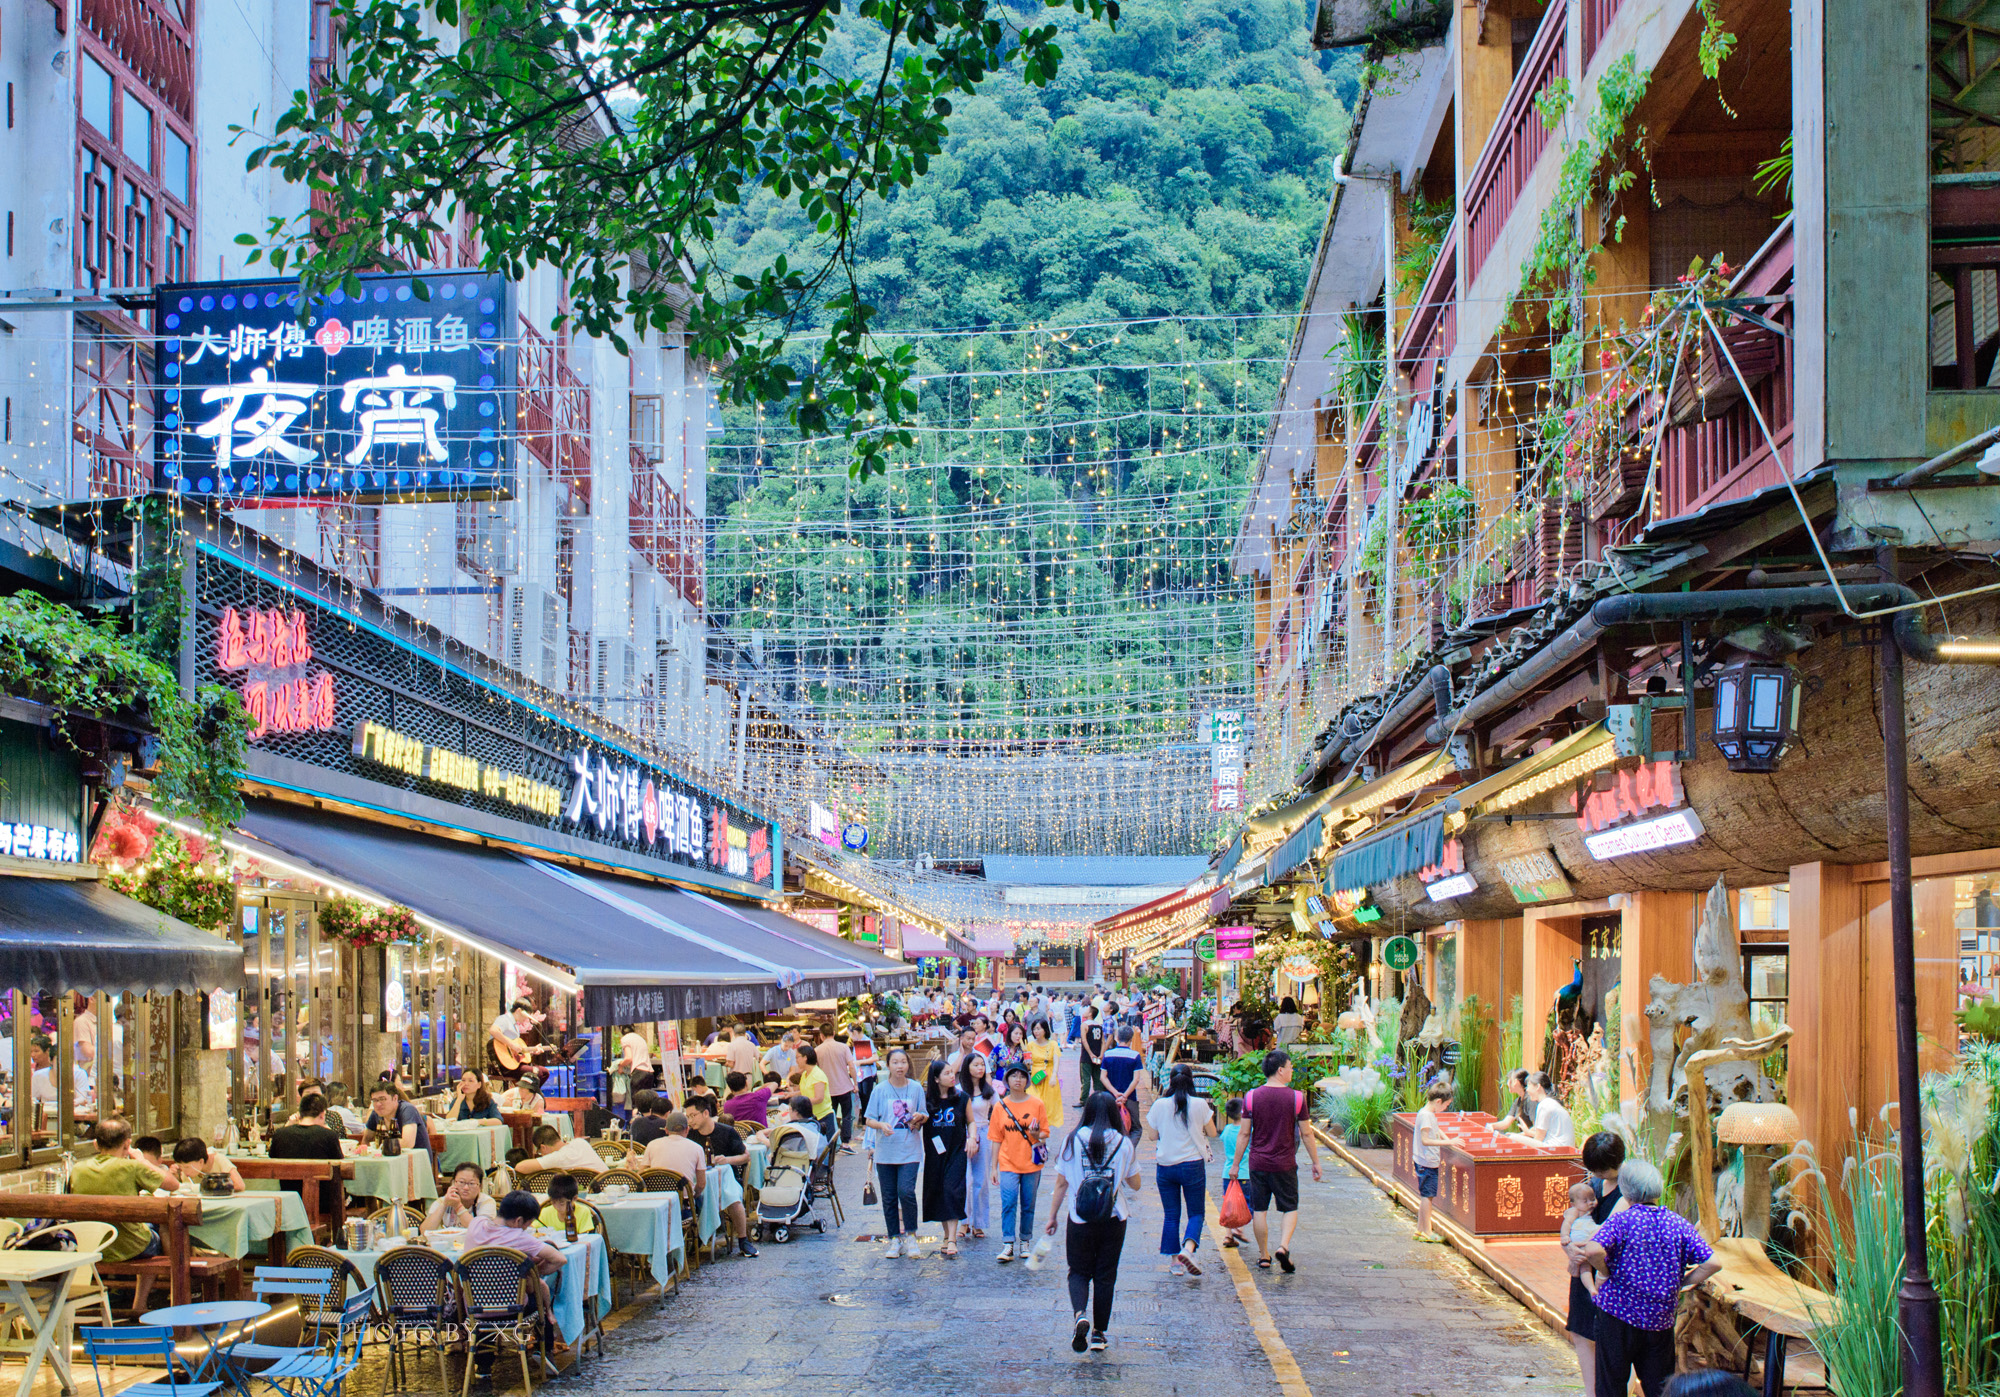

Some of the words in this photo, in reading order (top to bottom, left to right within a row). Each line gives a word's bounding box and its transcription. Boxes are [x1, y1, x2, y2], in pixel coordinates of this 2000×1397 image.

[322, 331, 345, 345] 金奖
[353, 314, 470, 355] 啤酒鱼
[196, 364, 457, 469] 夜宵
[1217, 723, 1241, 809] 比萨厨房
[658, 784, 704, 861] 啤酒鱼
[1587, 838, 1628, 857] Surnames
[1623, 826, 1657, 849] Cultural
[1656, 822, 1690, 841] Center
[1092, 1028, 1102, 1040] 18
